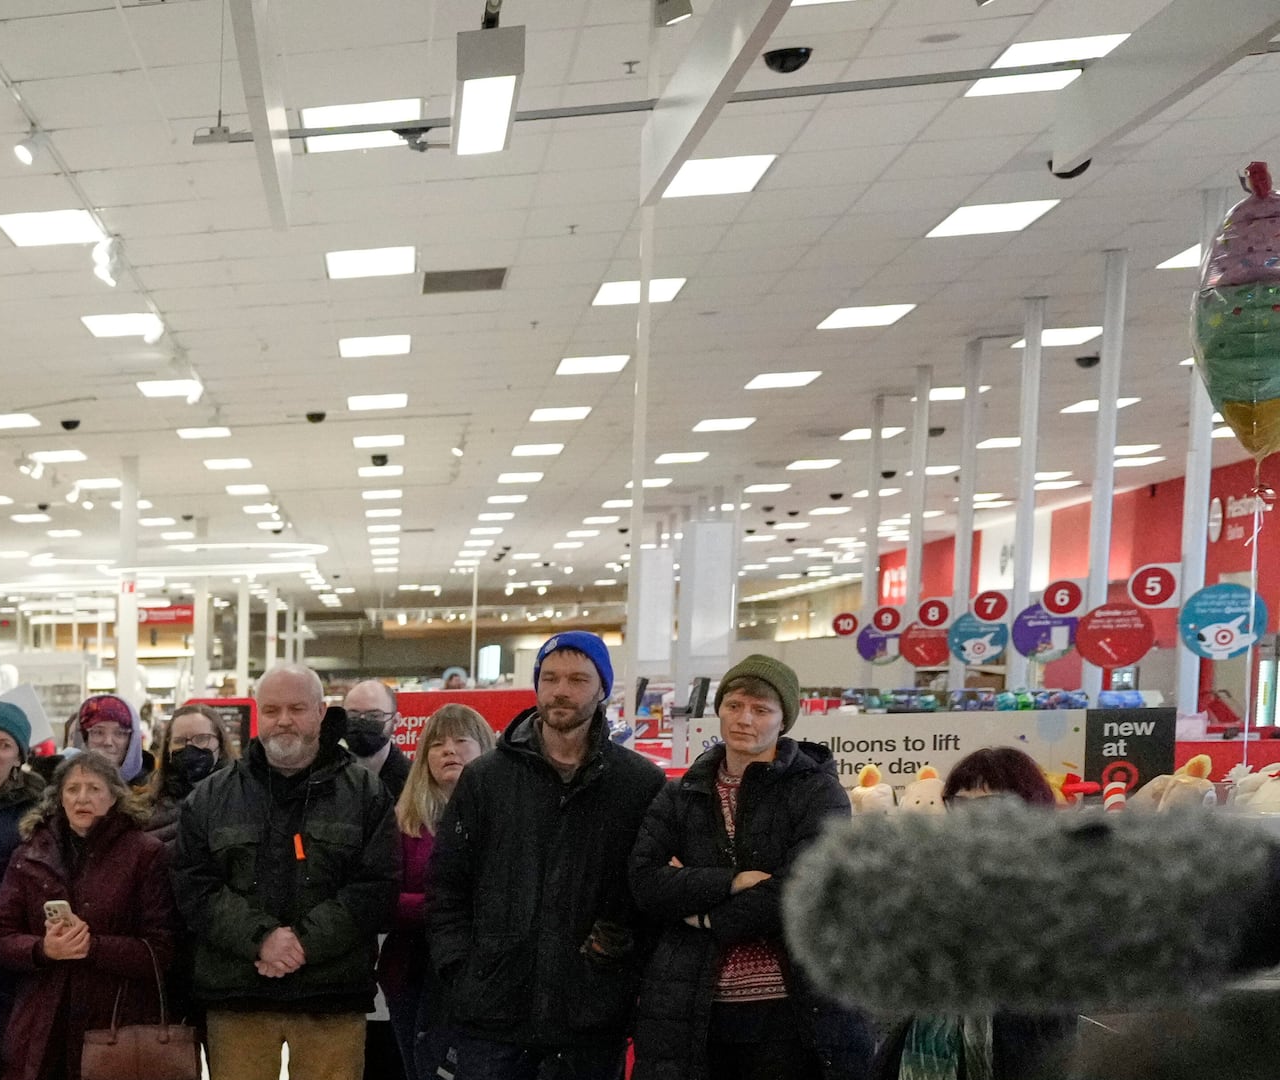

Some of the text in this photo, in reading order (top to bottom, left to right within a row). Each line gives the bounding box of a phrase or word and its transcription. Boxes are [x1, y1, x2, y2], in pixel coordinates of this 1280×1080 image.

[1144, 576, 1162, 596] 5
[1054, 588, 1070, 606] 6
[927, 606, 940, 621] 8
[983, 598, 998, 614] 7
[838, 619, 854, 631] 10
[881, 613, 892, 626] 9
[1103, 721, 1156, 737] new
[803, 733, 961, 752] alloons to lift
[1102, 739, 1128, 757] at
